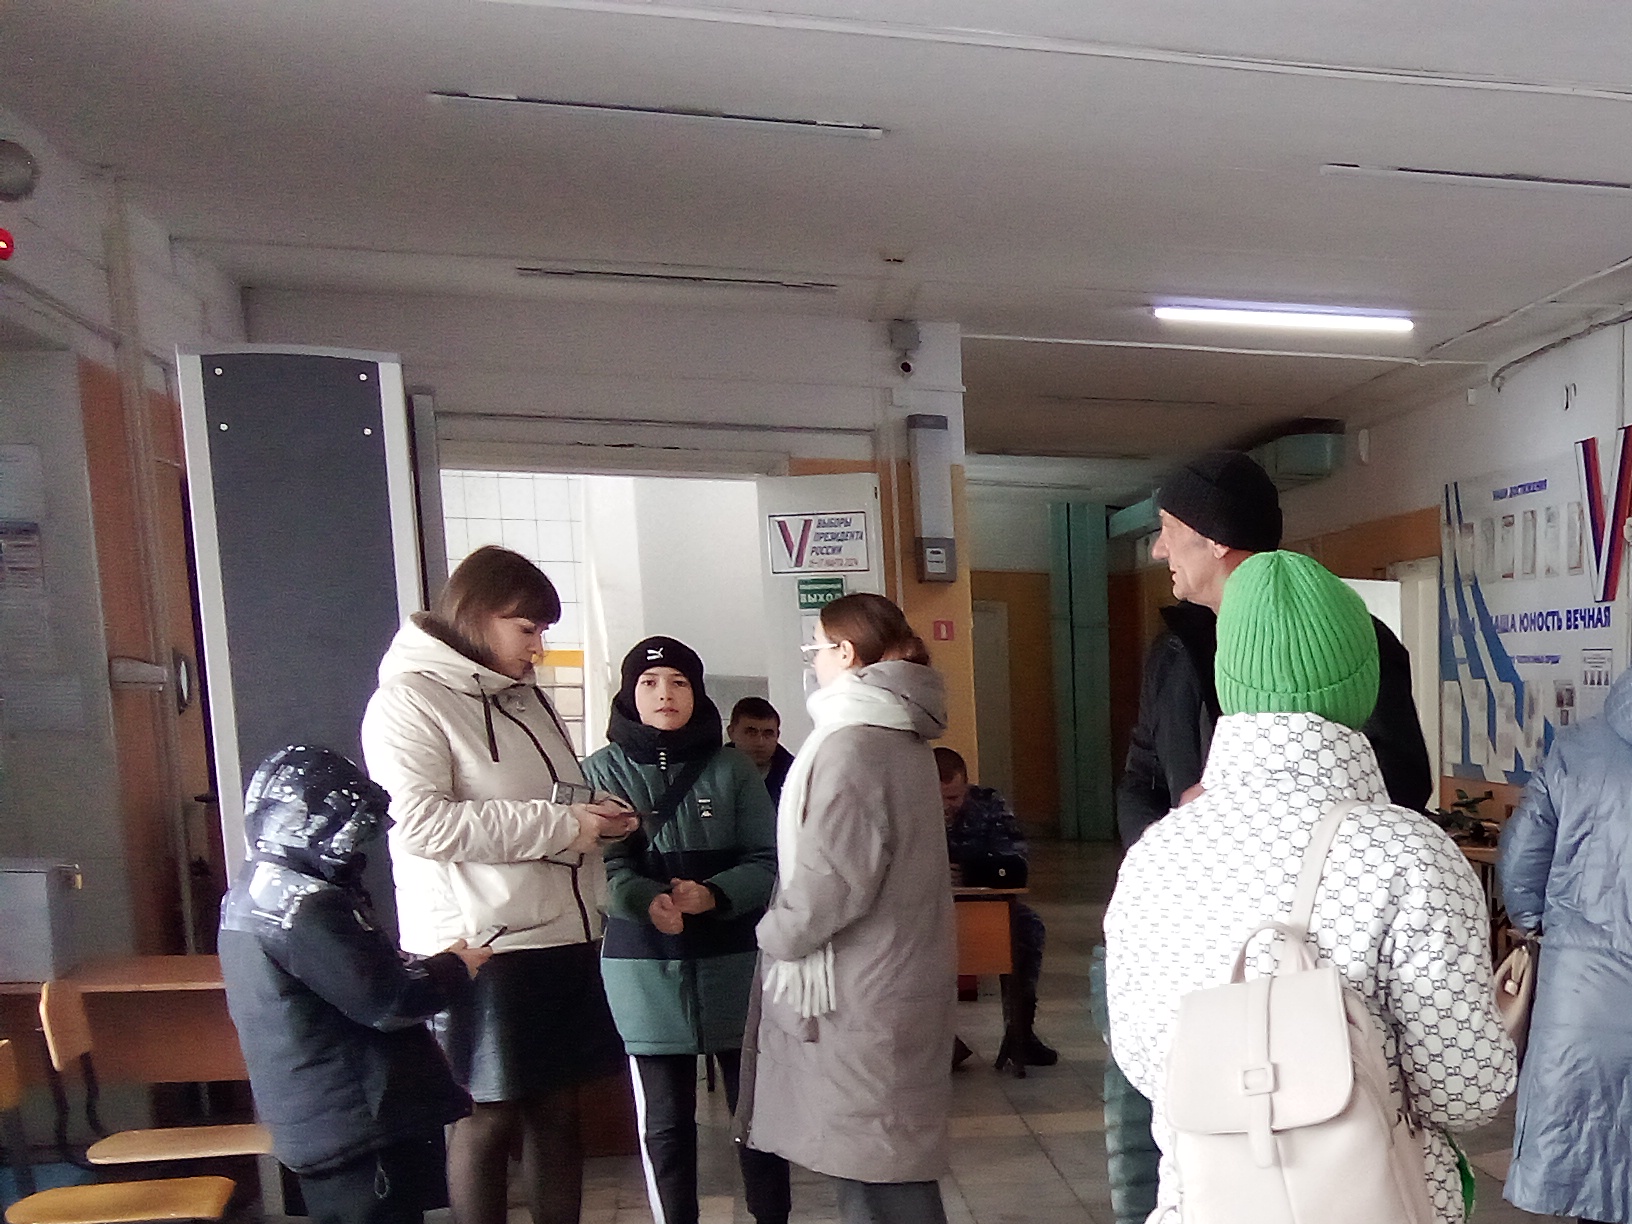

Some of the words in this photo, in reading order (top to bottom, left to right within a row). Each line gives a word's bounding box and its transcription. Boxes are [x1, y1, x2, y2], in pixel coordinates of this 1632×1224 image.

[816, 517, 852, 529] ВЫБОРЫ
[813, 530, 864, 542] ПРЕЗИДЕНТА
[810, 545, 843, 556] РОССИИ
[1520, 610, 1563, 633] ЮНОСТЬ
[1565, 606, 1611, 630] ВЕЧНАЯ
